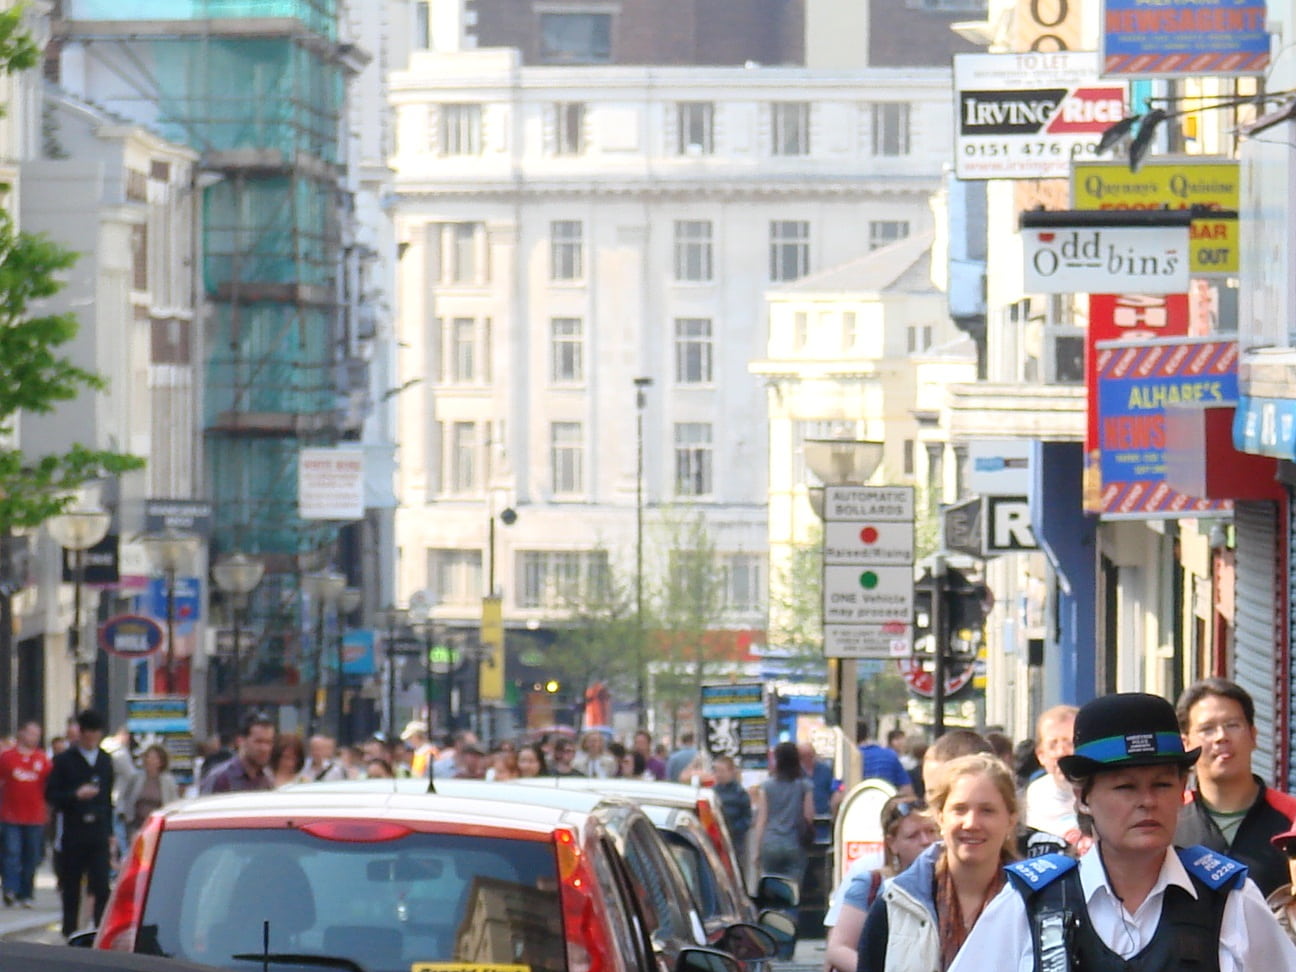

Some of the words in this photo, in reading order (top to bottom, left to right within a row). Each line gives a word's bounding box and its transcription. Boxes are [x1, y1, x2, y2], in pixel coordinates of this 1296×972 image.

[965, 98, 1056, 126] IRVING
[1062, 96, 1123, 123] RICE
[964, 143, 1009, 156] 0151
[1023, 143, 1061, 156] 476
[1197, 248, 1230, 265] OUT
[833, 491, 907, 502] AUTOMATIC
[835, 504, 904, 516] BOLLARDS
[830, 592, 857, 604] ONE
[862, 592, 906, 604] Vehicle
[828, 608, 854, 617] may
